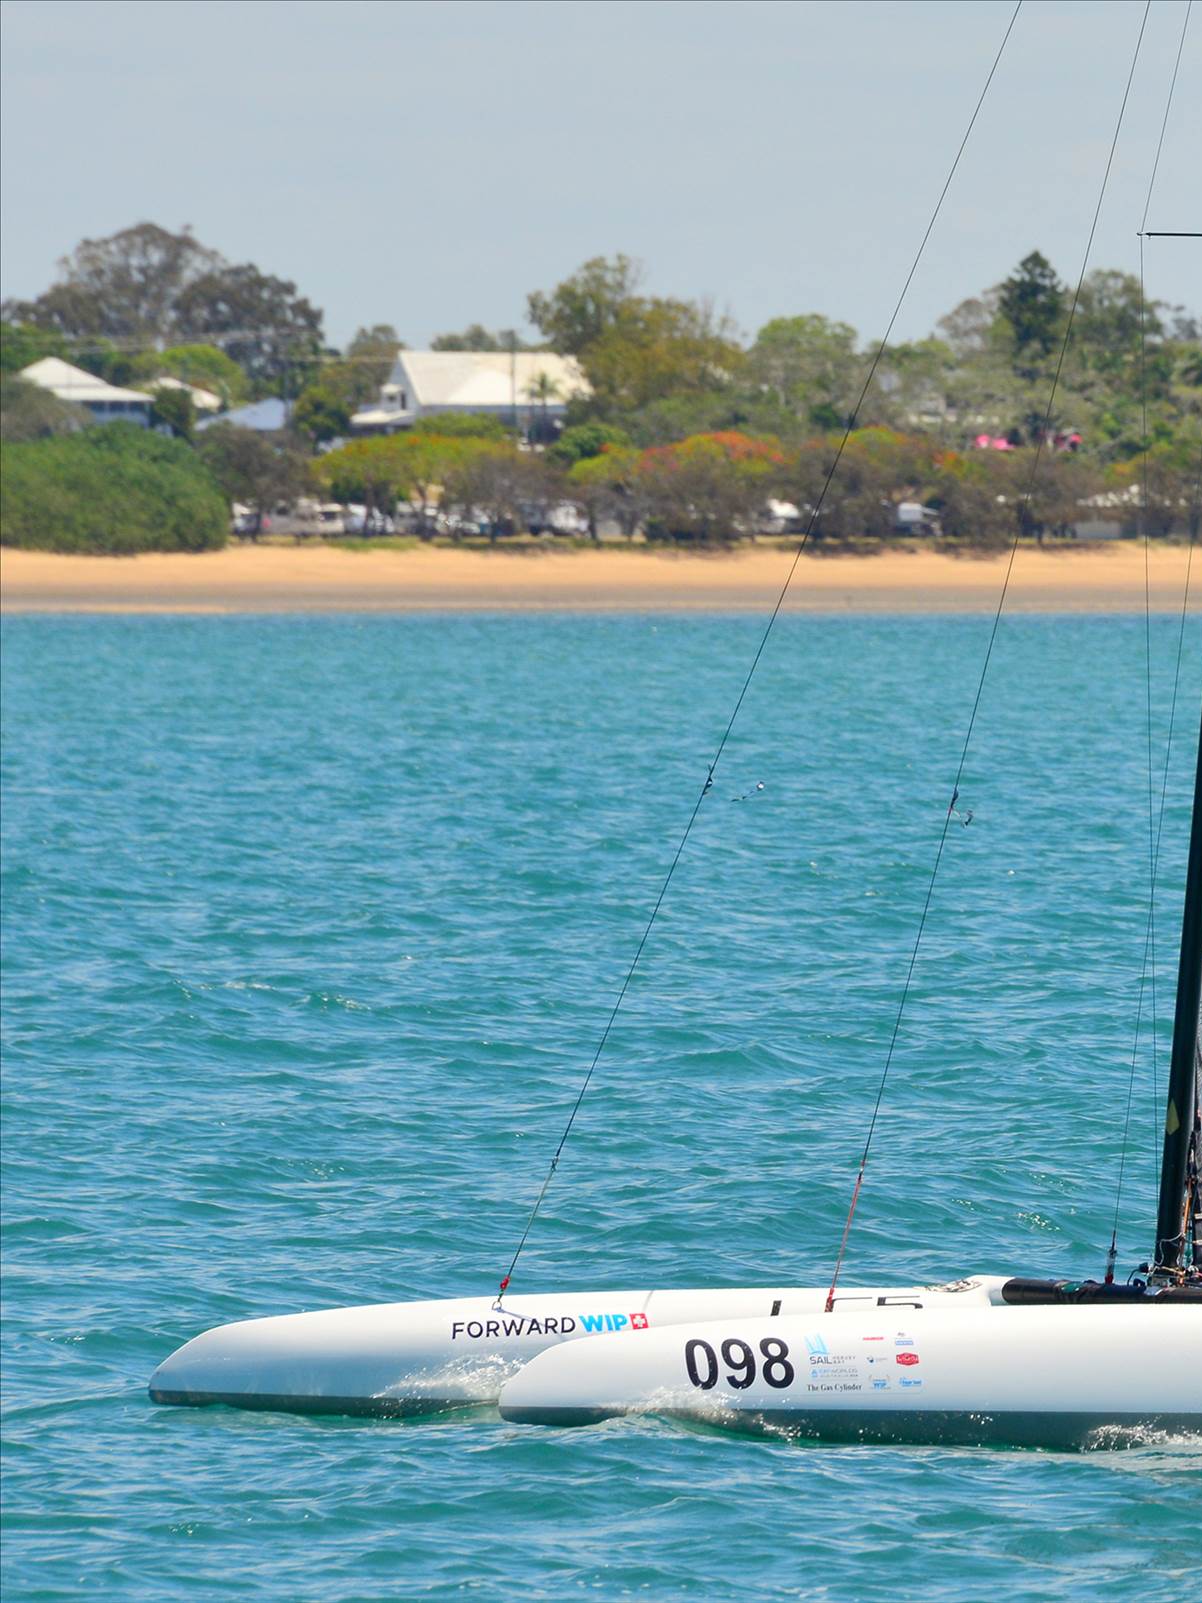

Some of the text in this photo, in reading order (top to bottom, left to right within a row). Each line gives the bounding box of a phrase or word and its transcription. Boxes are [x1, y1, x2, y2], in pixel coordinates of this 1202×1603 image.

[452, 1313, 628, 1340] FORWARD WIP
[685, 1337, 795, 1390] 098
[809, 1355, 832, 1365] SAIL
[807, 1383, 819, 1392] The
[820, 1383, 833, 1392] Gas
[834, 1383, 862, 1393] Cylinder
